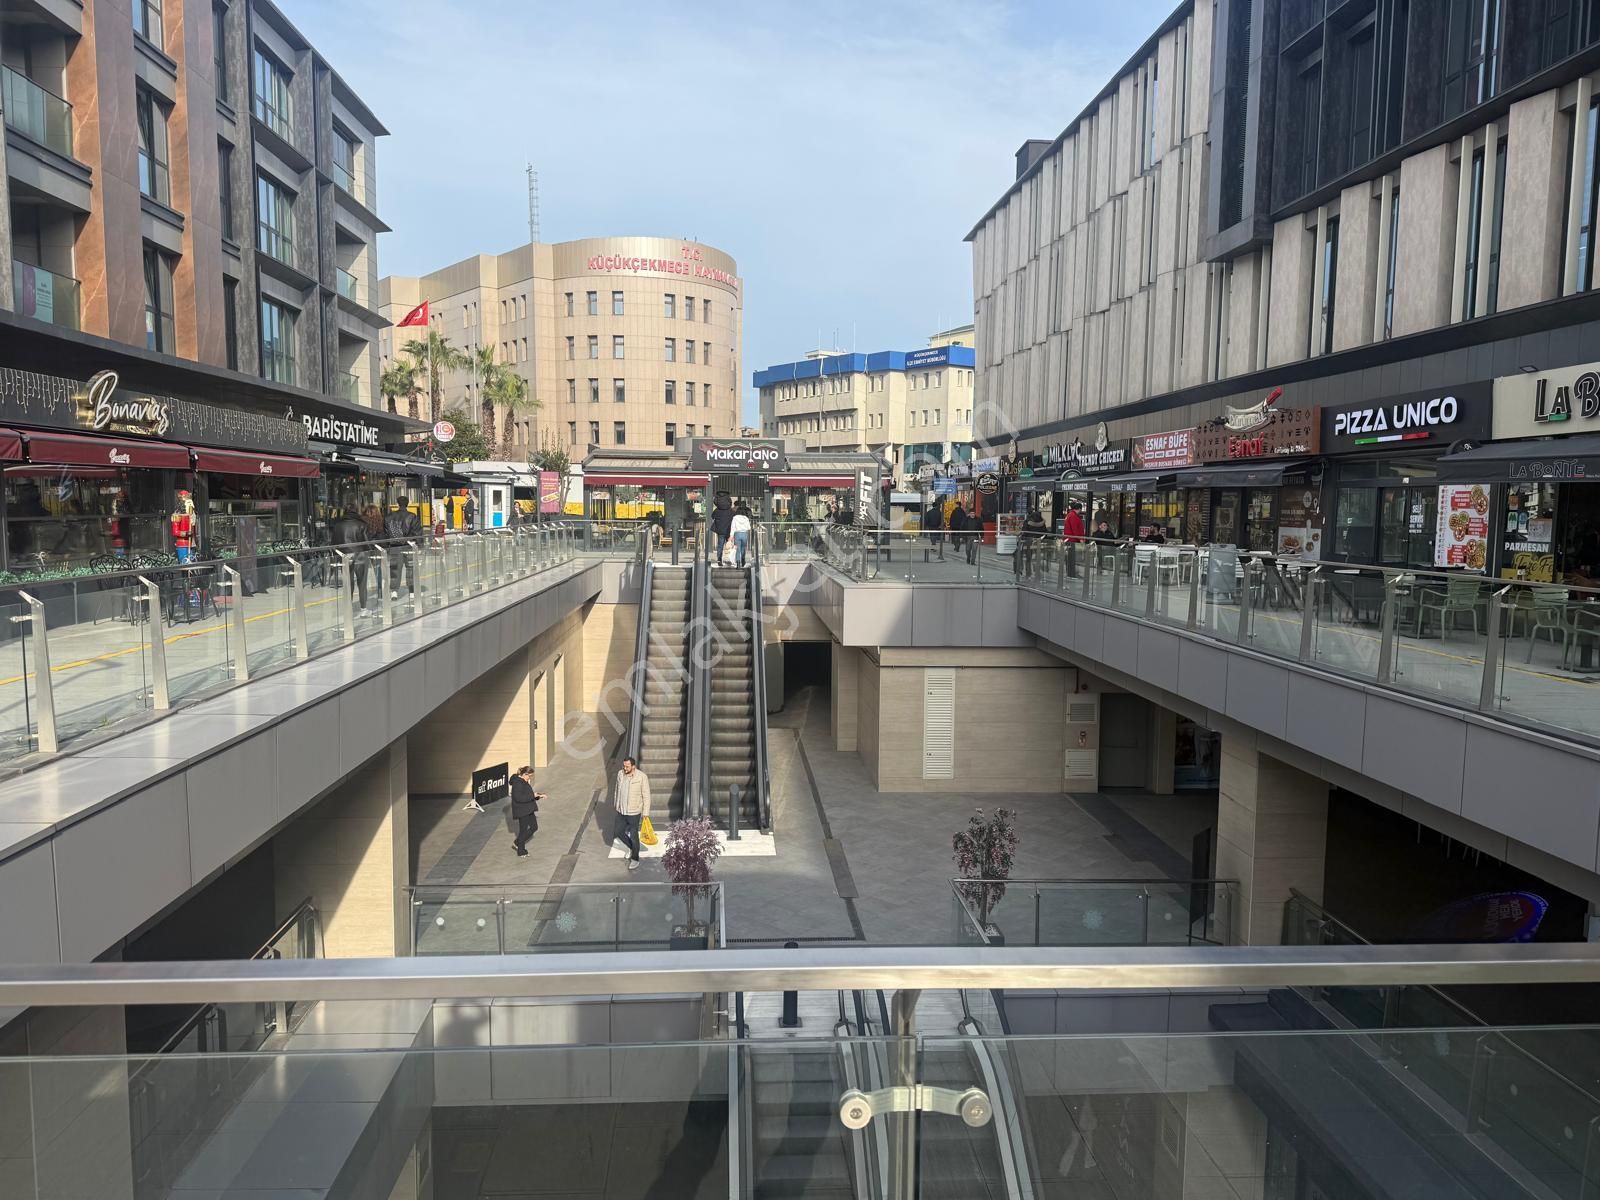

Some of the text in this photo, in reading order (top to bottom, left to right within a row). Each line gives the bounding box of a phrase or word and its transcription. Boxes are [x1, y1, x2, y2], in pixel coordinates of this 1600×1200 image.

[587, 254, 690, 276] KÜÇÜKÇEKMECE
[1534, 378, 1572, 423] LA
[1334, 396, 1458, 436] PIZZA UNICO
[1145, 432, 1188, 451] ESNAF BÜFE
[1099, 449, 1125, 465] CHICKEN
[1509, 462, 1527, 479] LA
[1504, 541, 1549, 554] PARMESAN
[487, 774, 506, 791] Rani
